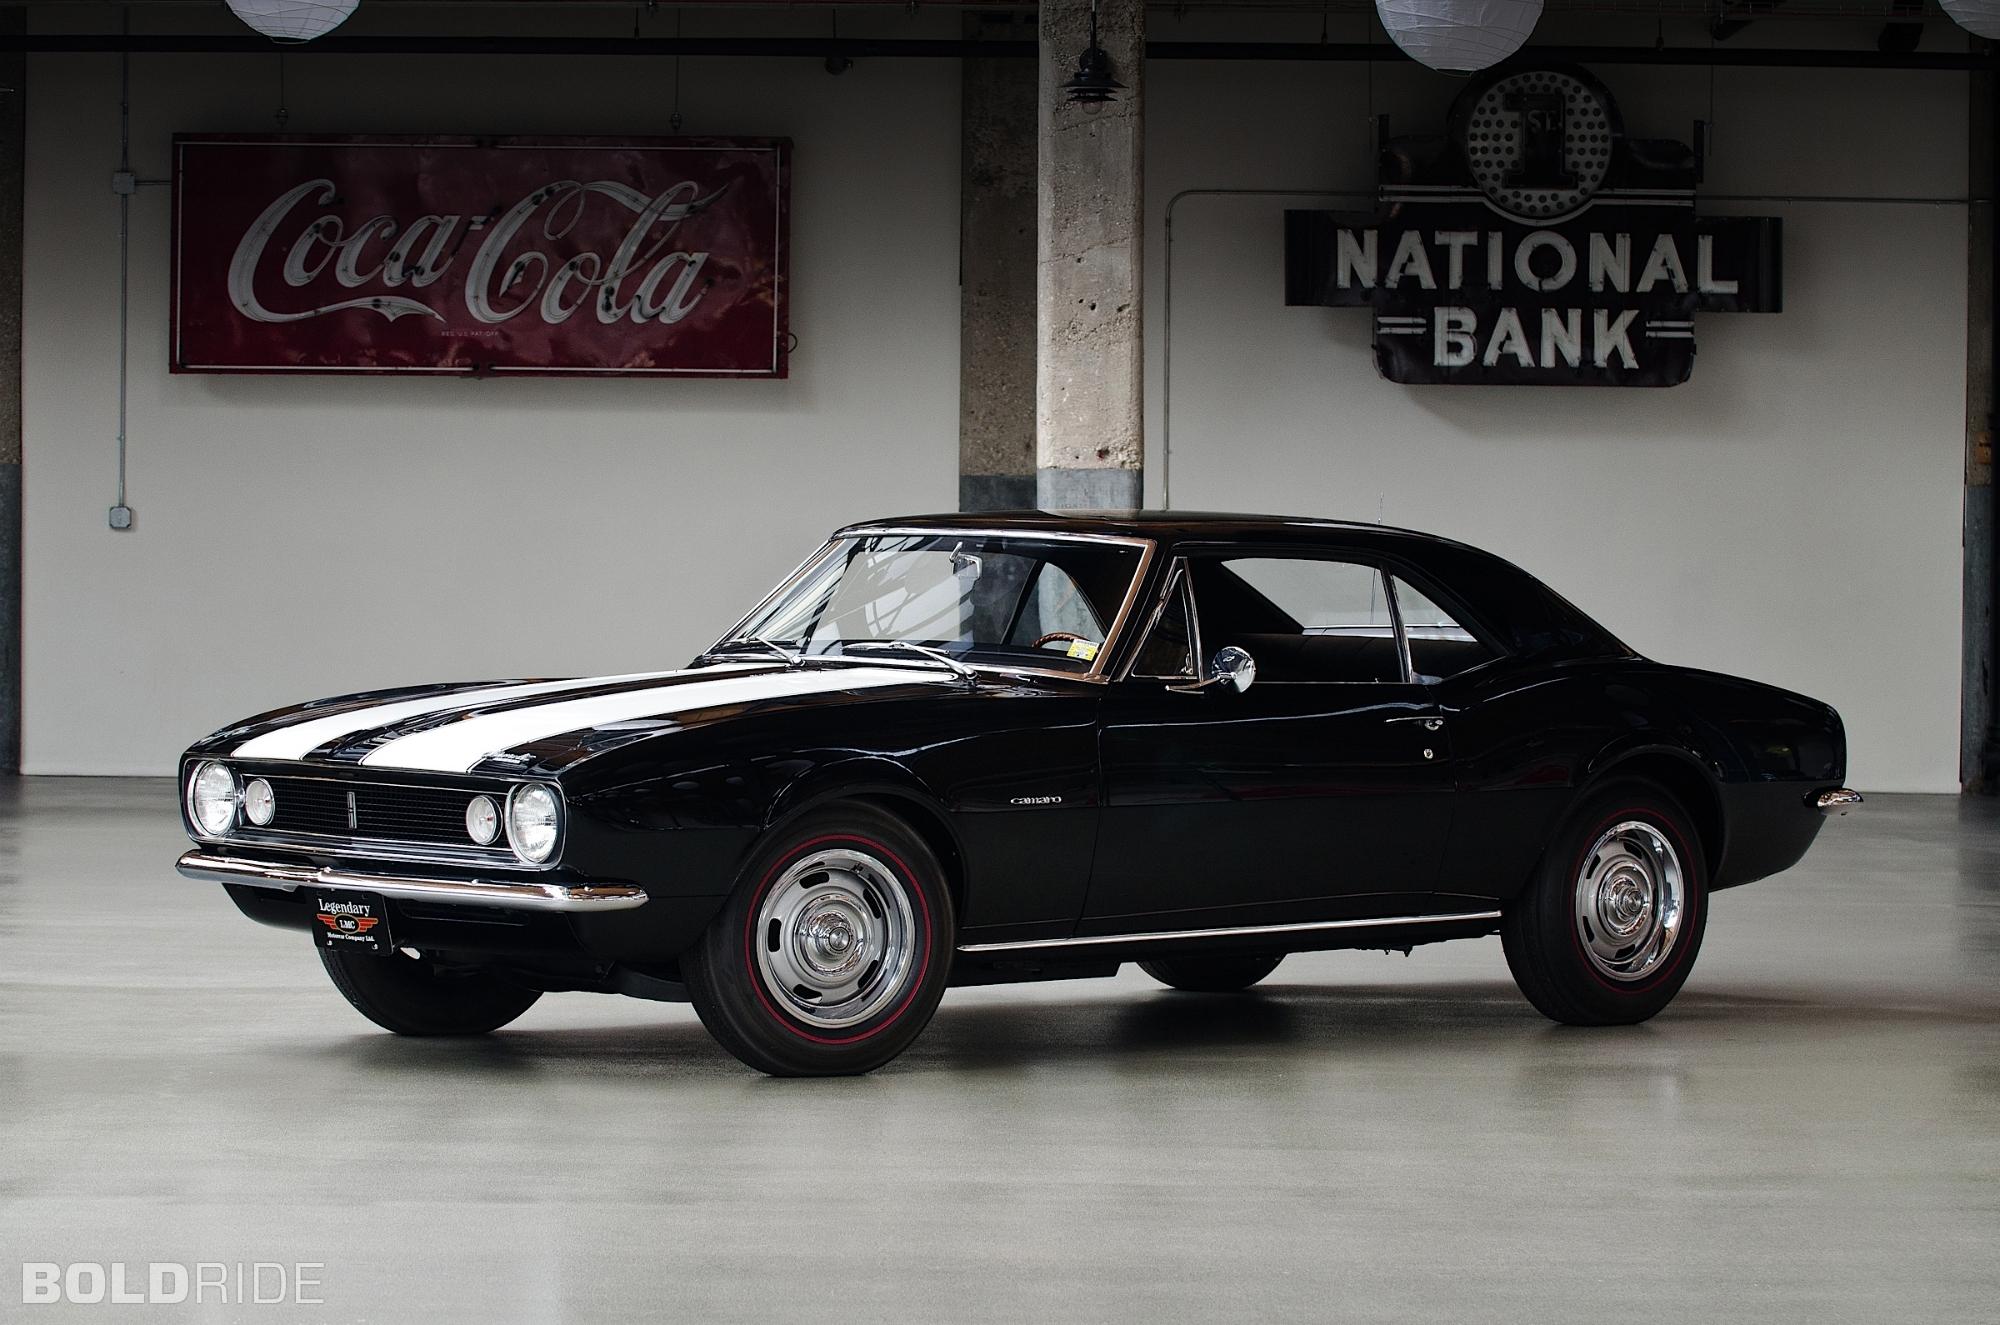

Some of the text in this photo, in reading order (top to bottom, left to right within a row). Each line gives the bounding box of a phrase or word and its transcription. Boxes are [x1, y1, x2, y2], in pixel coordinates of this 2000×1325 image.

[227, 178, 730, 325] Coca-Cola
[1336, 229, 1739, 294] NATIONAL
[1433, 305, 1640, 370] BANK
[317, 898, 370, 917] Legendary
[339, 919, 356, 929] LMC
